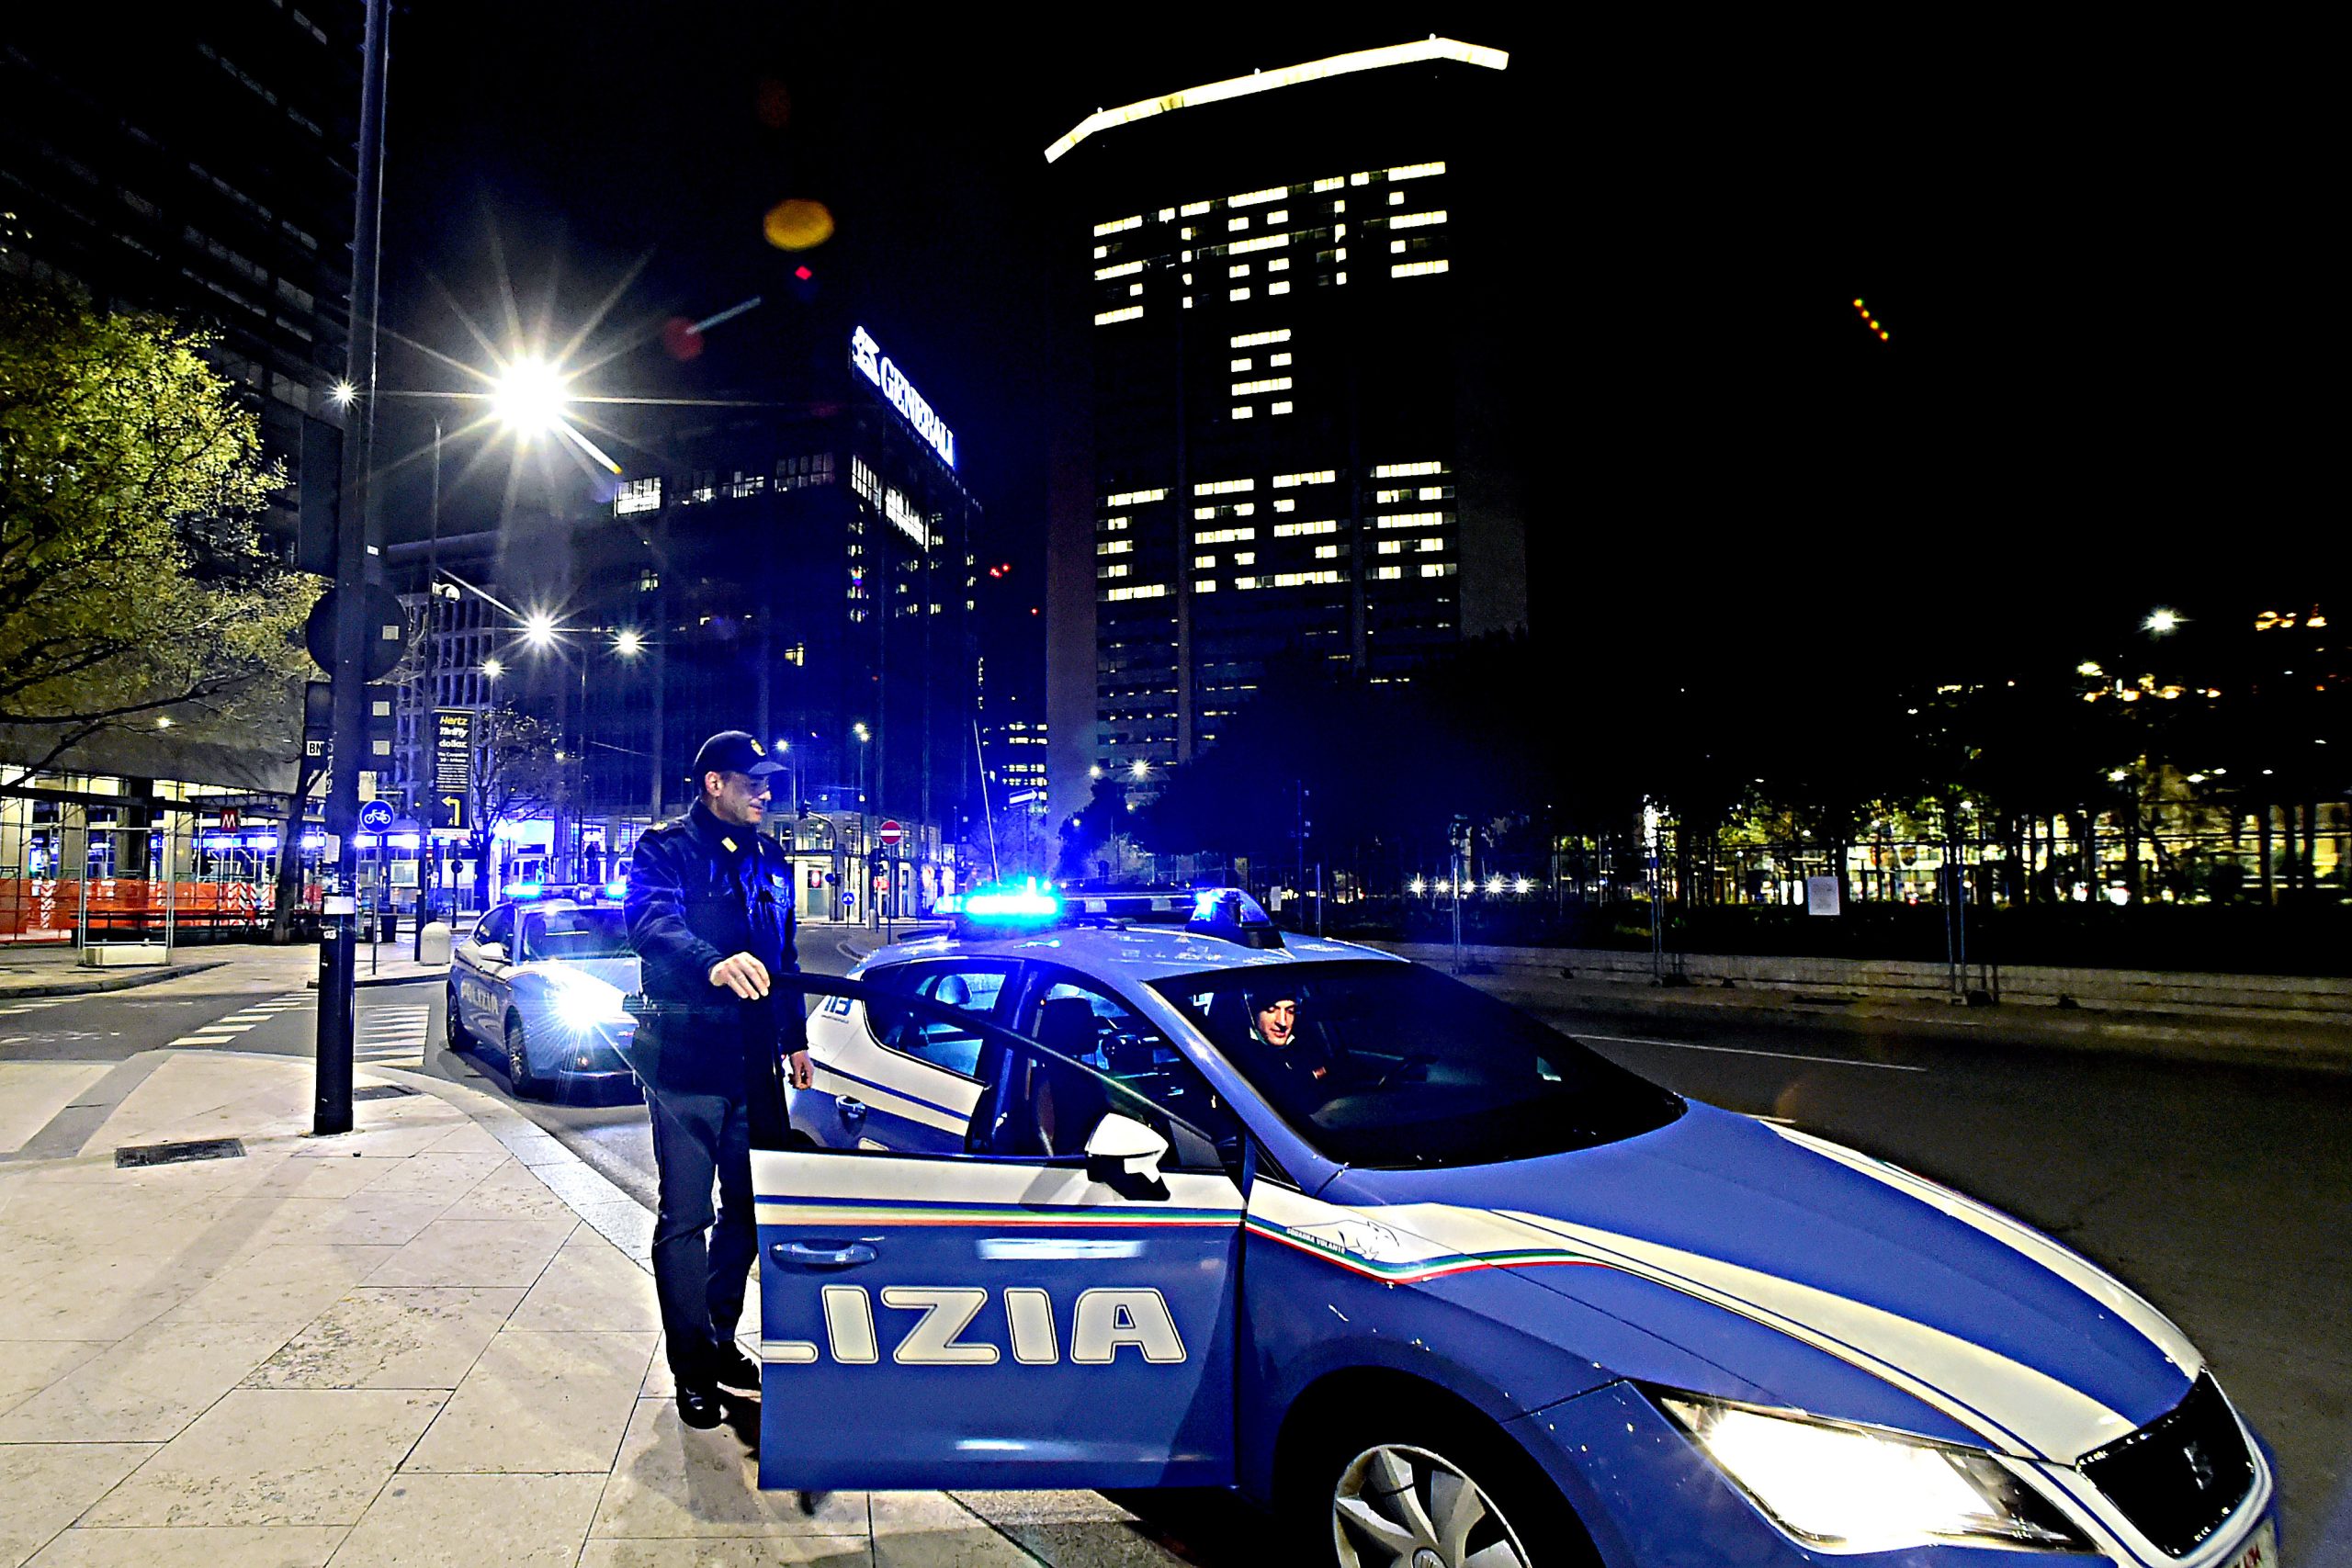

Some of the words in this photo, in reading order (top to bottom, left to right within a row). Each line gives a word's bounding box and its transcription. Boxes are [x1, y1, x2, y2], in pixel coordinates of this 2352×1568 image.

[1093, 162, 1449, 326] STATE
[880, 356, 955, 468] GENERALI
[1230, 328, 1294, 420] A
[1105, 460, 1445, 602] CASA
[439, 716, 469, 726] Hertz
[439, 727, 469, 739] Thrifty
[460, 978, 500, 1016] POLIZIA
